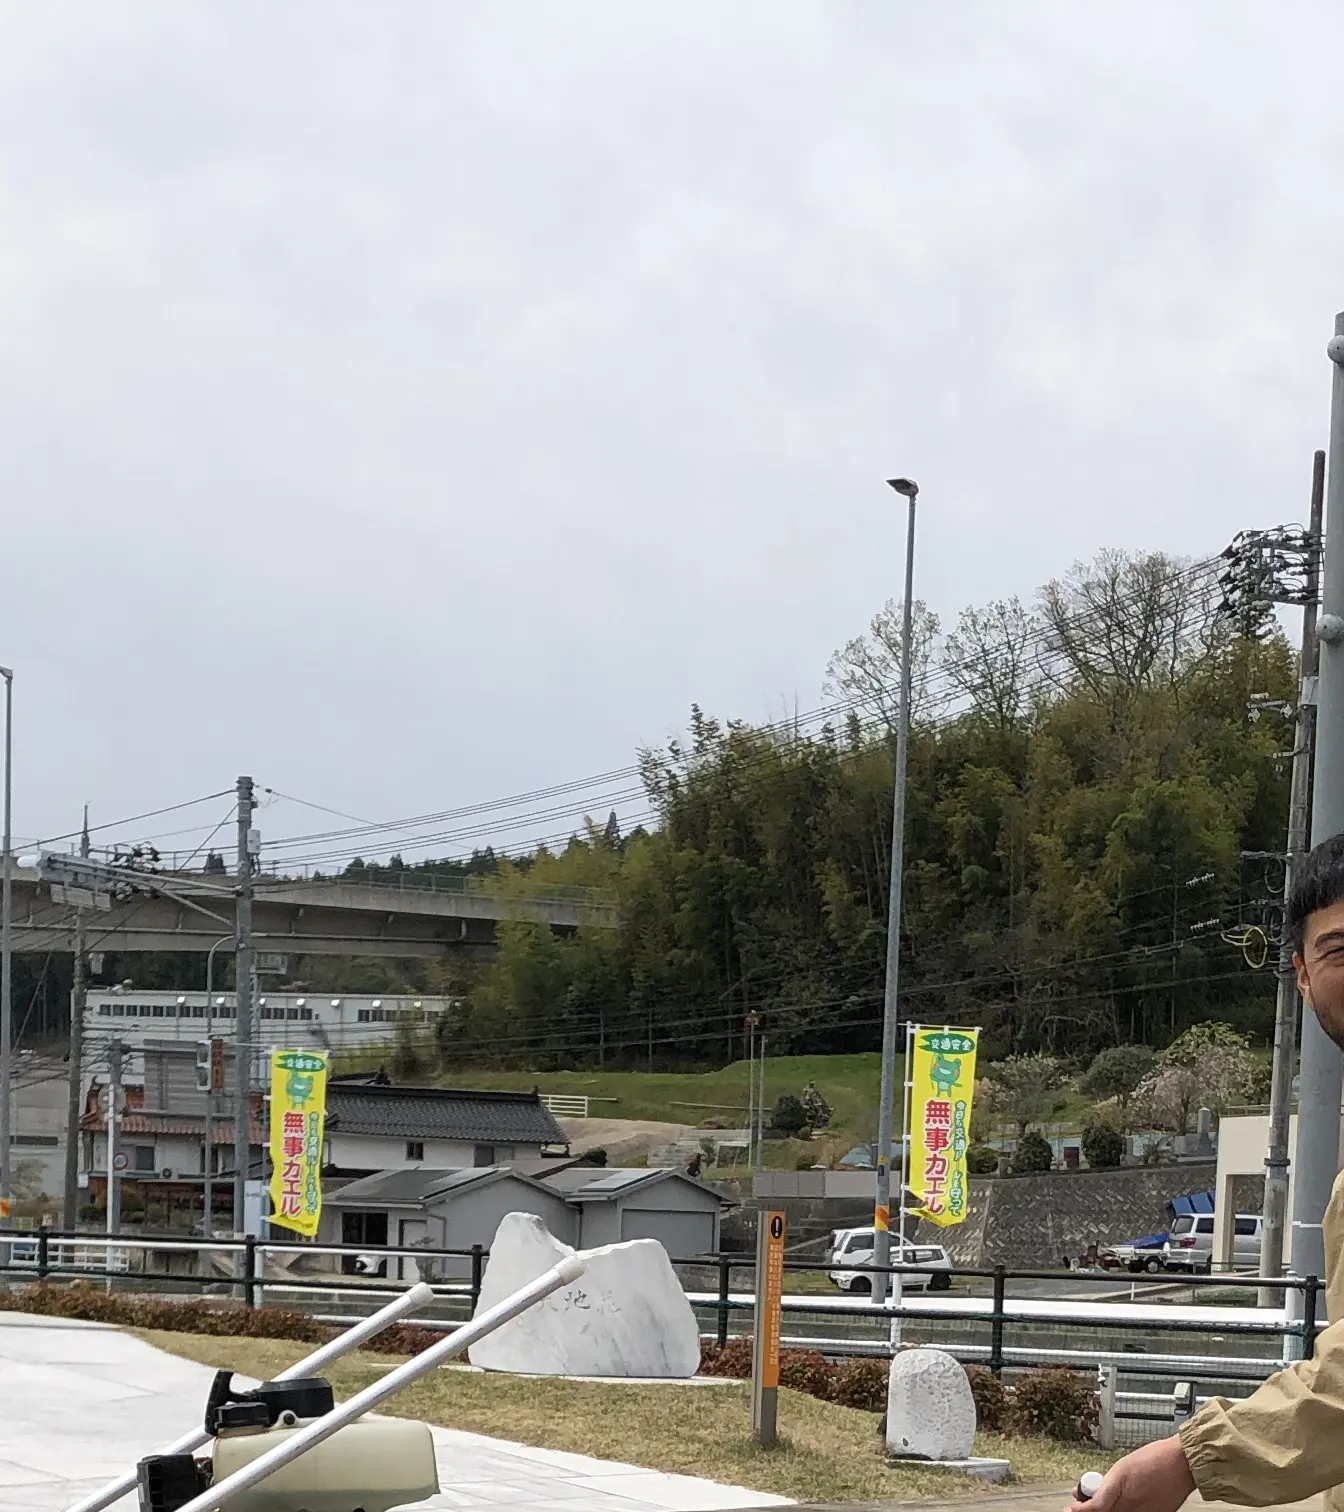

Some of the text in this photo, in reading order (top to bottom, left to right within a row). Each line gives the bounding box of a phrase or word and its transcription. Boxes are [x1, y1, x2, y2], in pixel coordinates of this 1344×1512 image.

[931, 1038, 972, 1051] 交通安全
[282, 1112, 305, 1216] 無事カエル
[924, 1100, 950, 1214] 無事カエル
